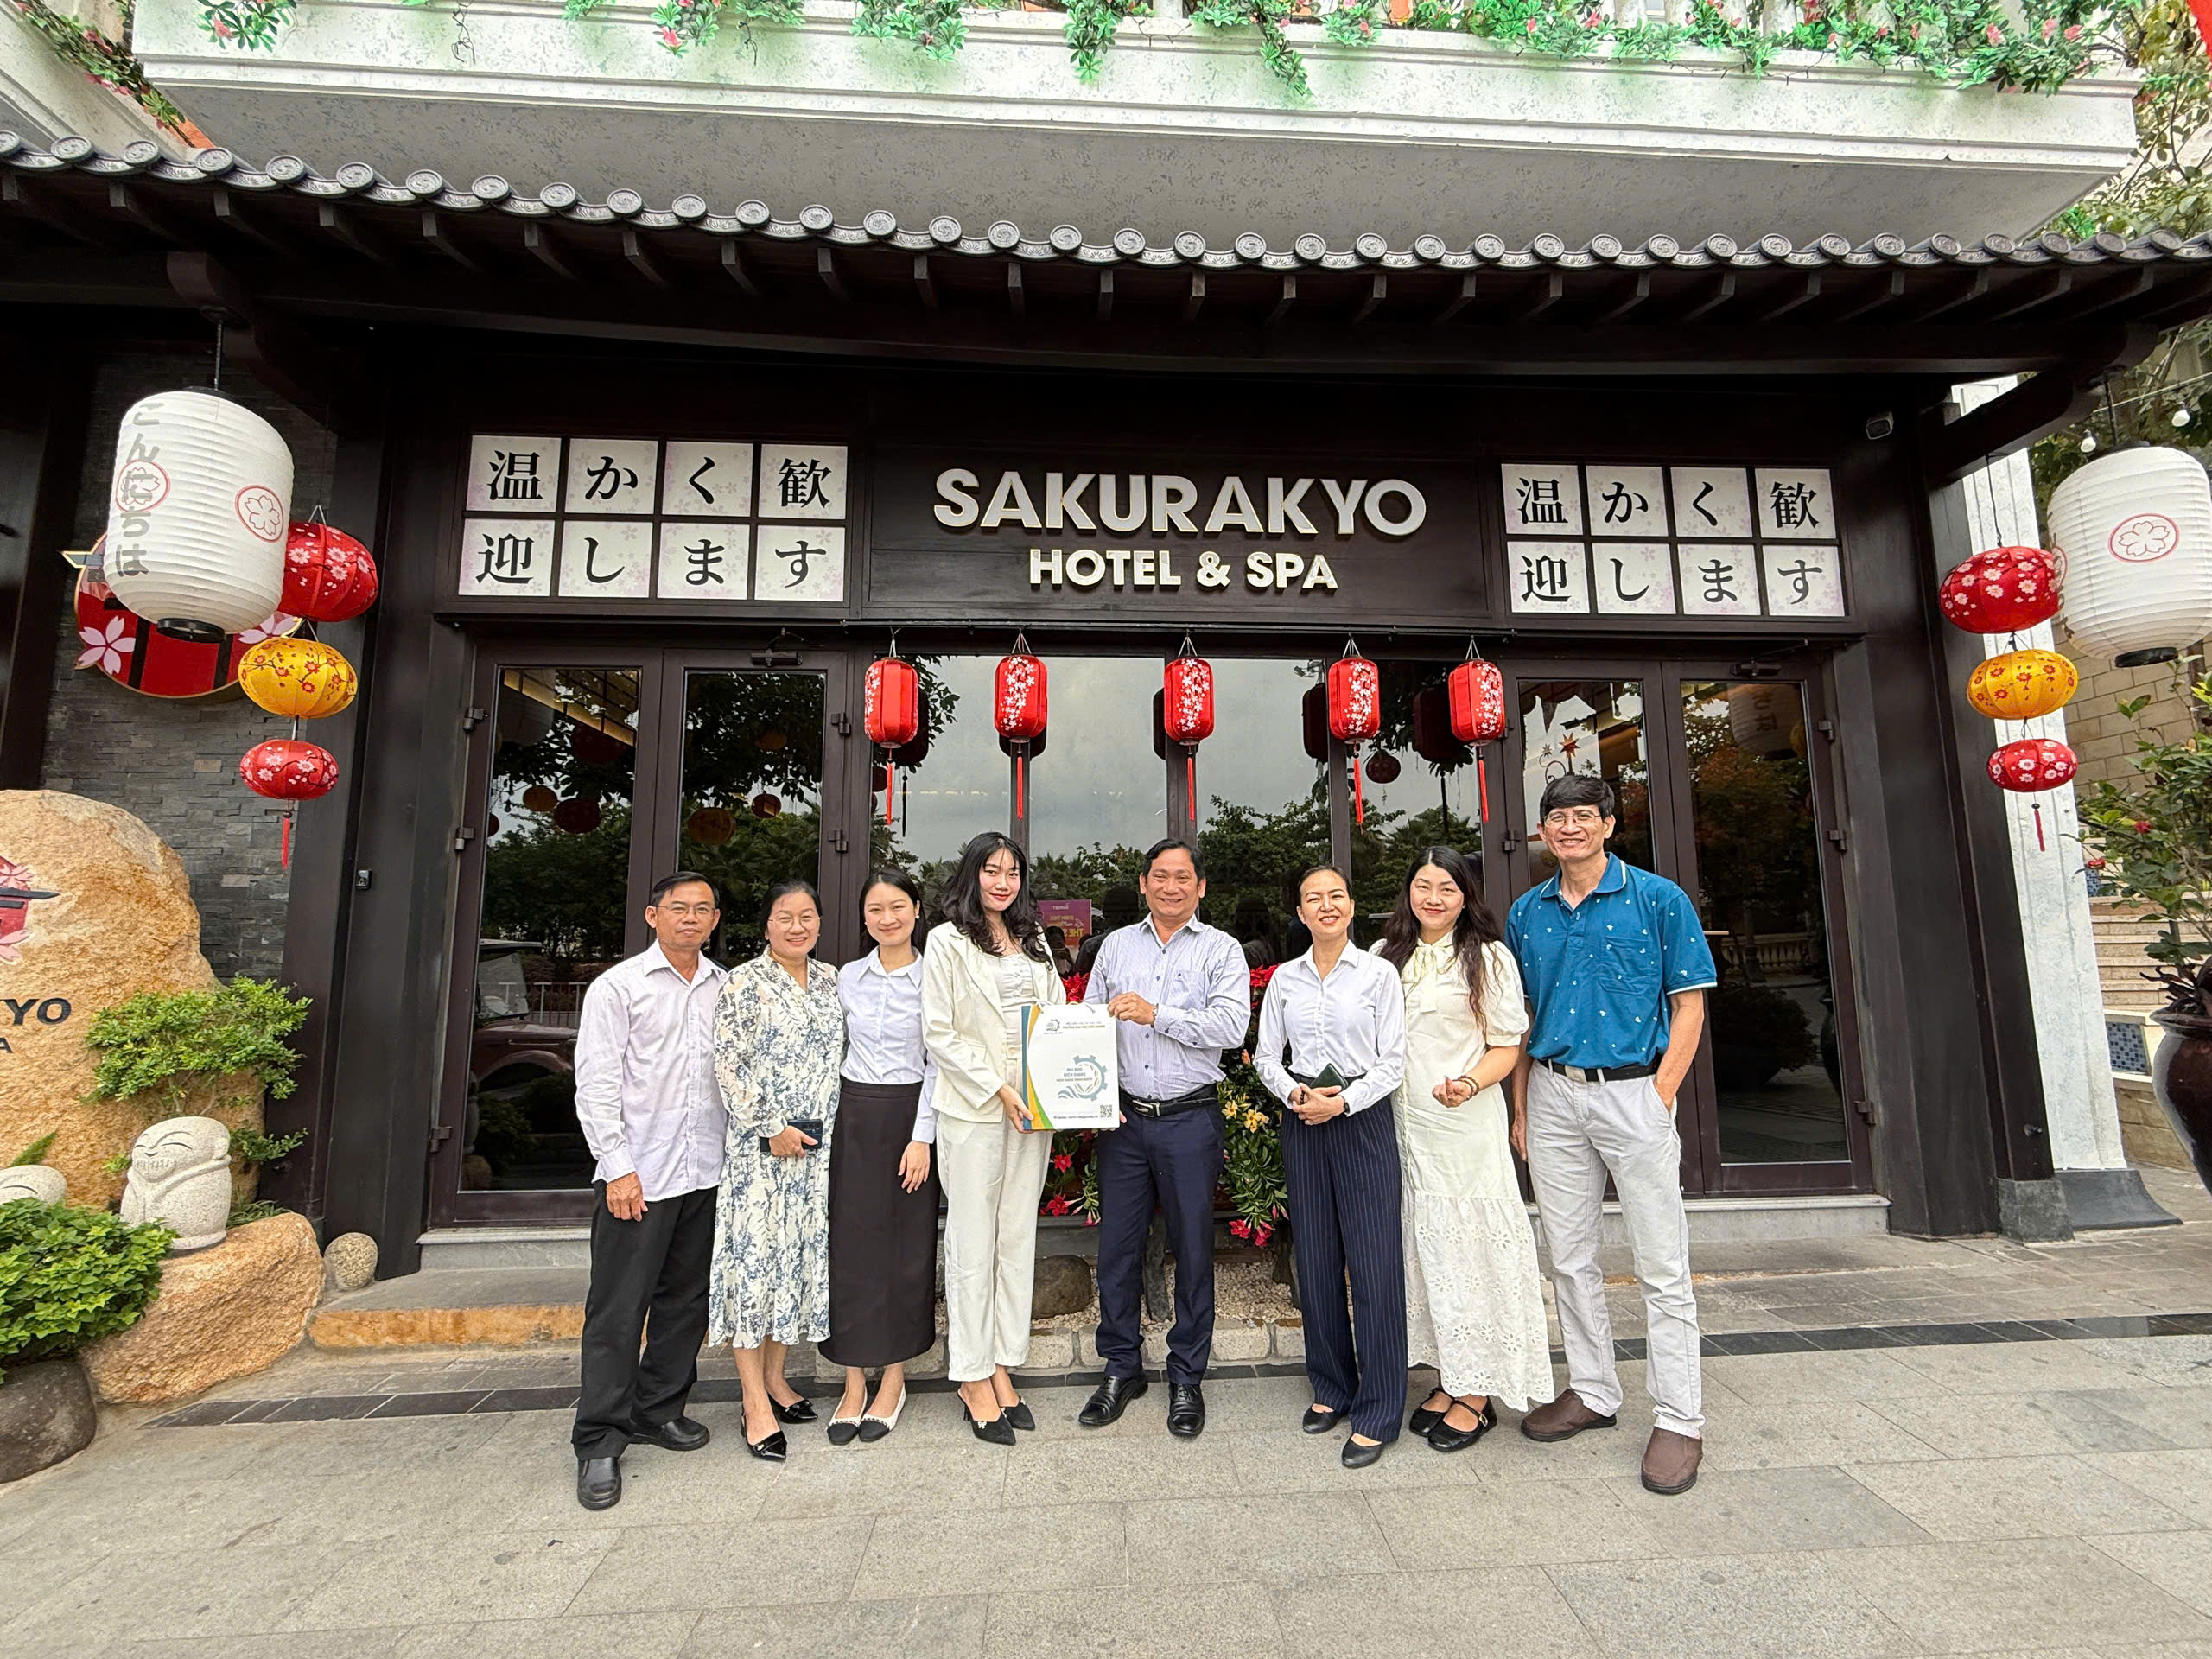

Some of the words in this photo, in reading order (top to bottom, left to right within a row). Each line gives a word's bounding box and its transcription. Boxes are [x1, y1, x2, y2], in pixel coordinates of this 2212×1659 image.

[114, 401, 165, 578] こんにちは
[486, 449, 833, 509] 温かく歓
[933, 467, 1427, 537] SAKURAKYO
[1516, 476, 1820, 530] 温かく歓
[474, 532, 827, 589] 迎します
[1029, 548, 1182, 587] HOTEL
[1196, 550, 1232, 588] &
[1246, 550, 1339, 590] SPA
[1521, 555, 1823, 606] 迎します
[0, 997, 72, 1026] YO
